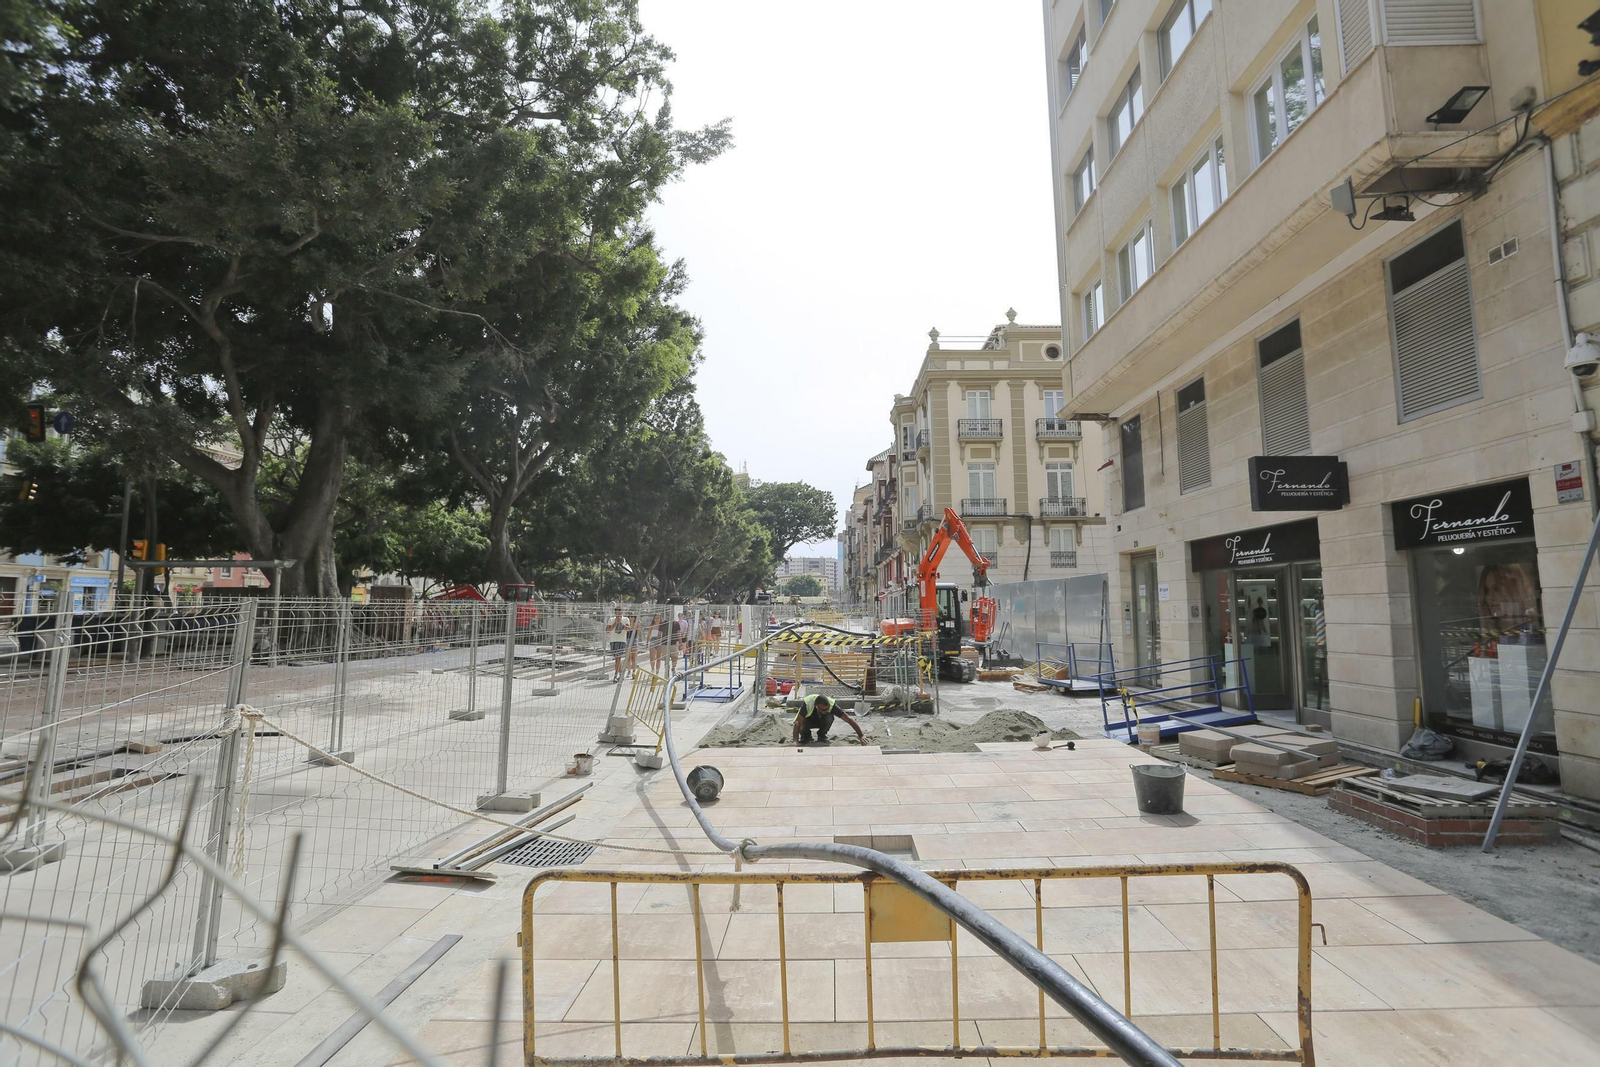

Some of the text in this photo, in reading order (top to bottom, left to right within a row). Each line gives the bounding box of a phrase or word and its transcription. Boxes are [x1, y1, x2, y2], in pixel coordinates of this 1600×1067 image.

[1259, 468, 1332, 494] Fernando
[1313, 489, 1334, 497] ESTÉTICA
[1410, 490, 1512, 540] Fernando
[1437, 529, 1476, 542] PELUQUERÍA
[1483, 526, 1517, 537] ESTÉTICA
[1225, 532, 1271, 563] Fernando
[1456, 728, 1474, 736] HOMBRE
[1497, 735, 1514, 744] NIÑOS
